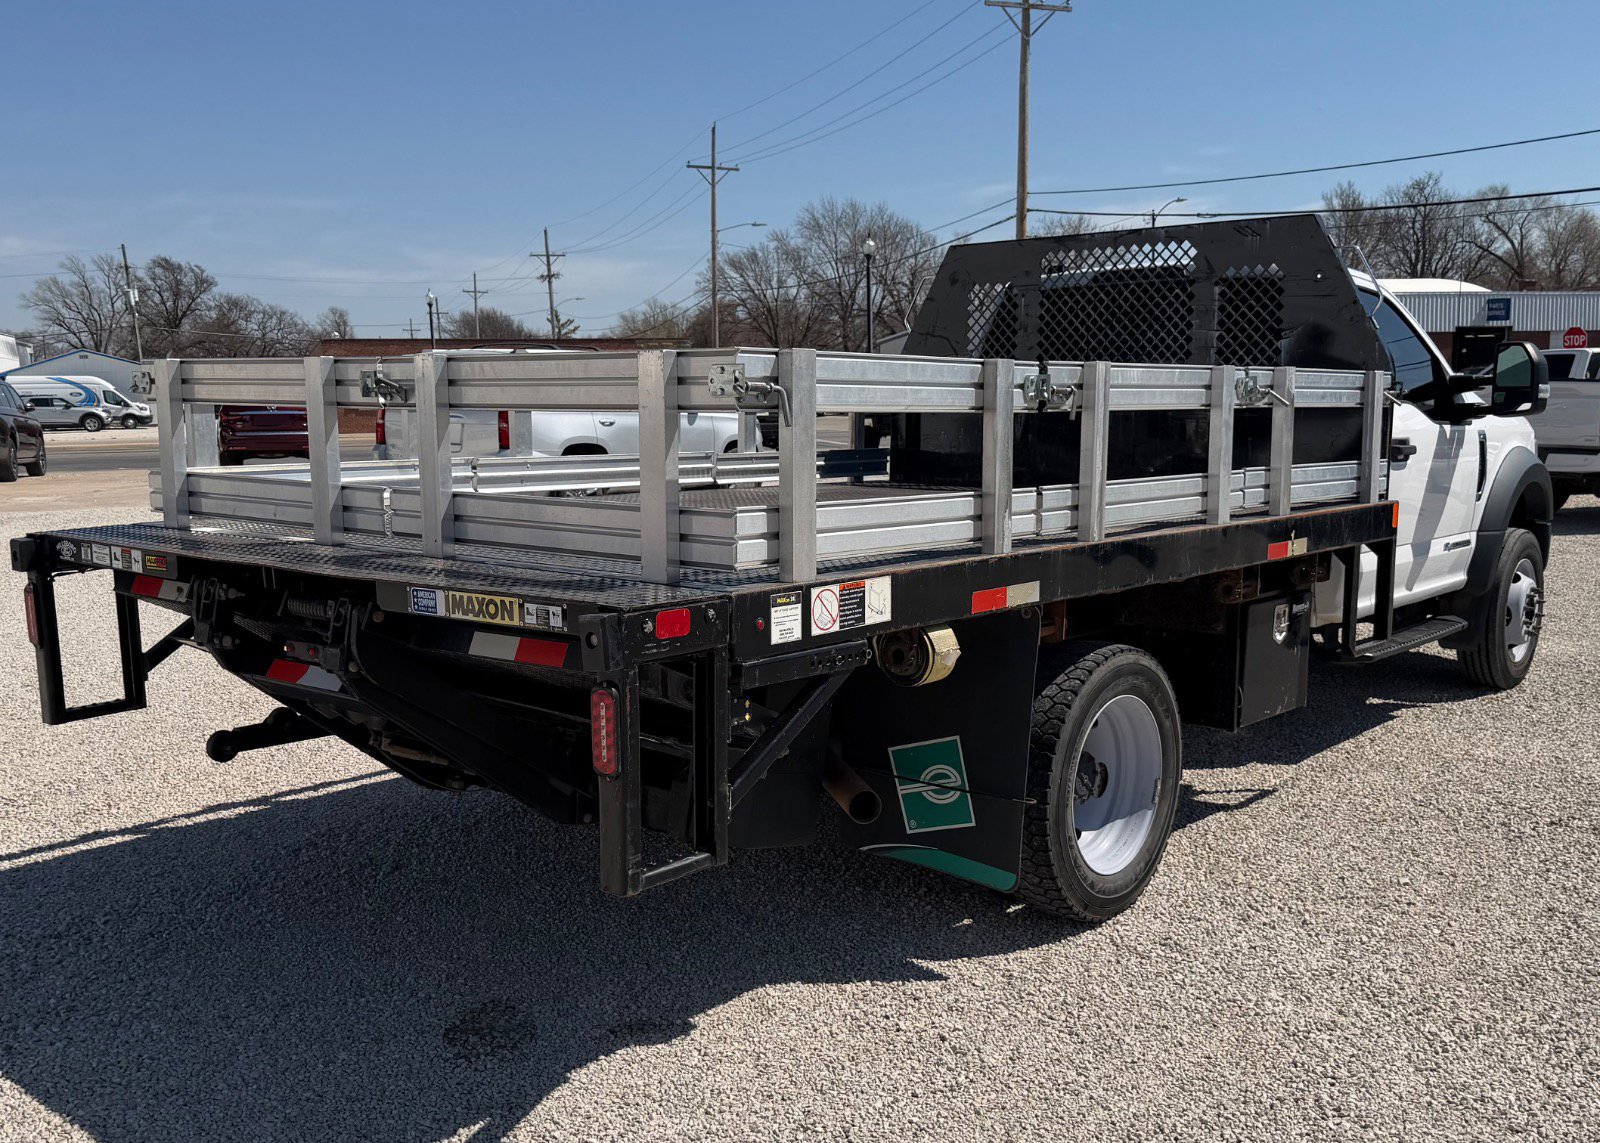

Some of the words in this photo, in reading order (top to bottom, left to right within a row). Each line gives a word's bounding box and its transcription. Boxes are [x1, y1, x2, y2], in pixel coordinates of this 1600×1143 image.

[1564, 335, 1586, 346] STOP
[417, 590, 436, 599] AMERICAN
[417, 598, 436, 608] COMPANY
[451, 593, 515, 622] MAXON
